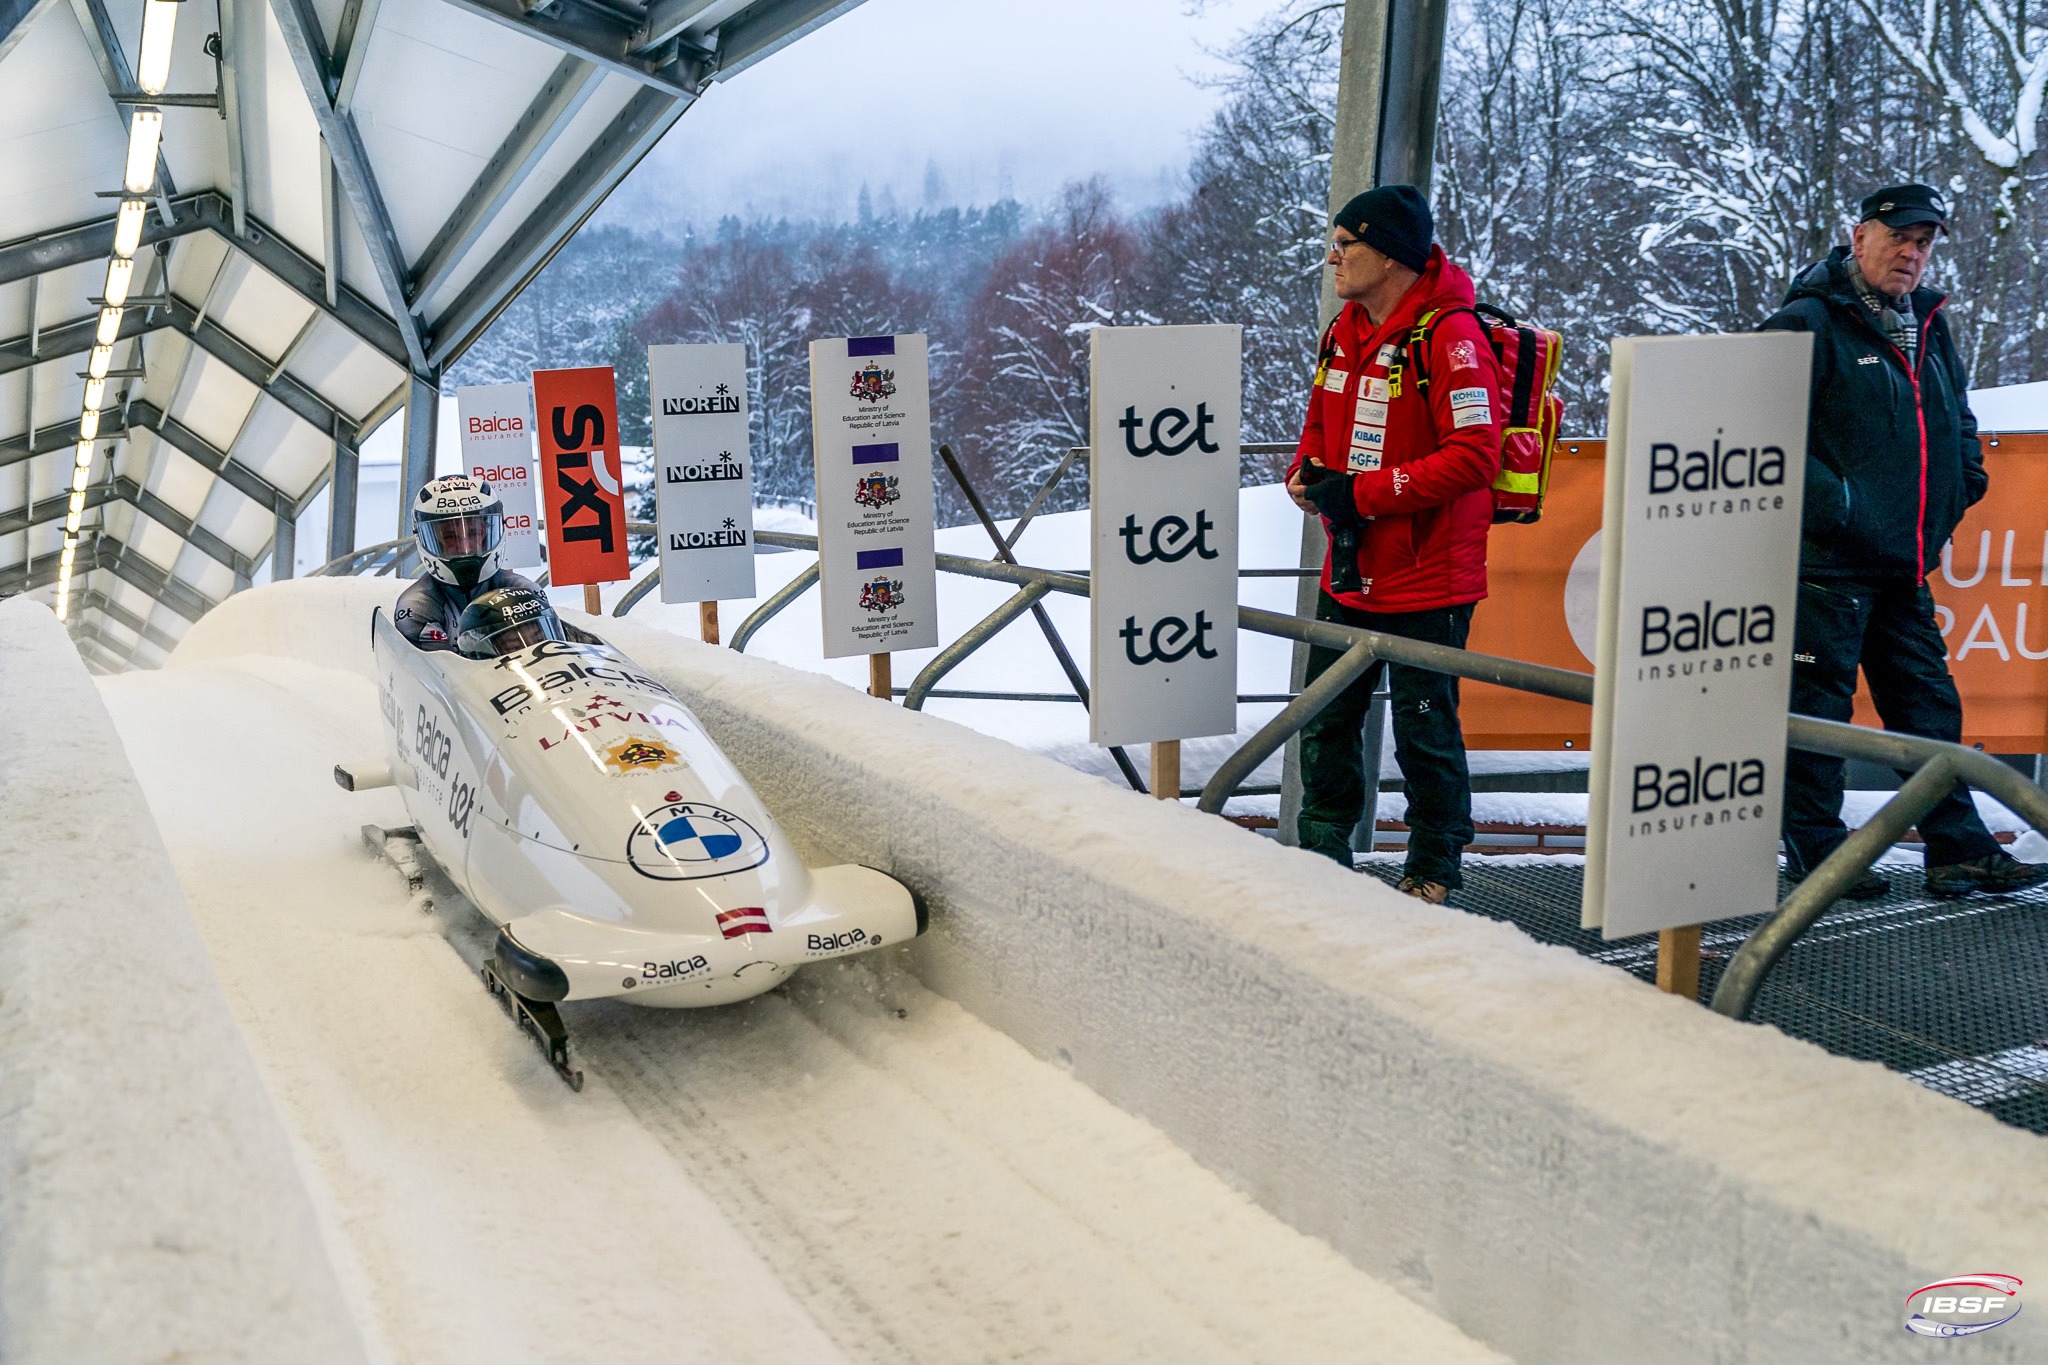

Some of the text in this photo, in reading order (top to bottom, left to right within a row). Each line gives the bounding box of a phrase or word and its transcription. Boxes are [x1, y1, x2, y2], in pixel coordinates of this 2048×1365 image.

[663, 396, 740, 415] NORFIN
[1452, 391, 1485, 402] KOHLER
[842, 413, 871, 422] Education
[859, 405, 881, 413] Ministry
[469, 416, 523, 433] Balcia
[849, 422, 874, 430] Republic
[1119, 401, 1220, 458] tet
[470, 432, 524, 441] insurance
[1354, 430, 1382, 443] KIBAG
[473, 465, 527, 482] Balcia
[667, 463, 743, 483] NORFIN
[1649, 439, 1785, 495] Balcia
[491, 481, 528, 489] urance
[552, 404, 615, 554] SIXT
[1392, 467, 1402, 496] OMEGA
[1647, 495, 1784, 520] insurance
[505, 515, 531, 529] cia
[847, 520, 875, 529] Education
[854, 528, 878, 536] Republic
[670, 530, 746, 551] NORFIN
[1119, 509, 1220, 565] tet
[488, 590, 532, 606] LATVIJA
[502, 599, 541, 617] Balcia
[851, 624, 880, 632] Education
[893, 621, 914, 629] Science
[858, 632, 882, 640] Republic
[1641, 601, 1775, 657] Balcia
[1119, 609, 1219, 665] tet
[1638, 652, 1773, 681] insurance
[489, 662, 672, 716] Balcia
[538, 711, 690, 750] LATVIJA
[416, 703, 451, 781] Balcia
[1632, 756, 1764, 814] Balcia
[449, 772, 476, 839] tet
[637, 805, 737, 837] BMW
[1629, 804, 1763, 837] insurance
[807, 927, 866, 951] Balcia
[639, 966, 712, 985] insurance
[642, 954, 708, 979] Balcia
